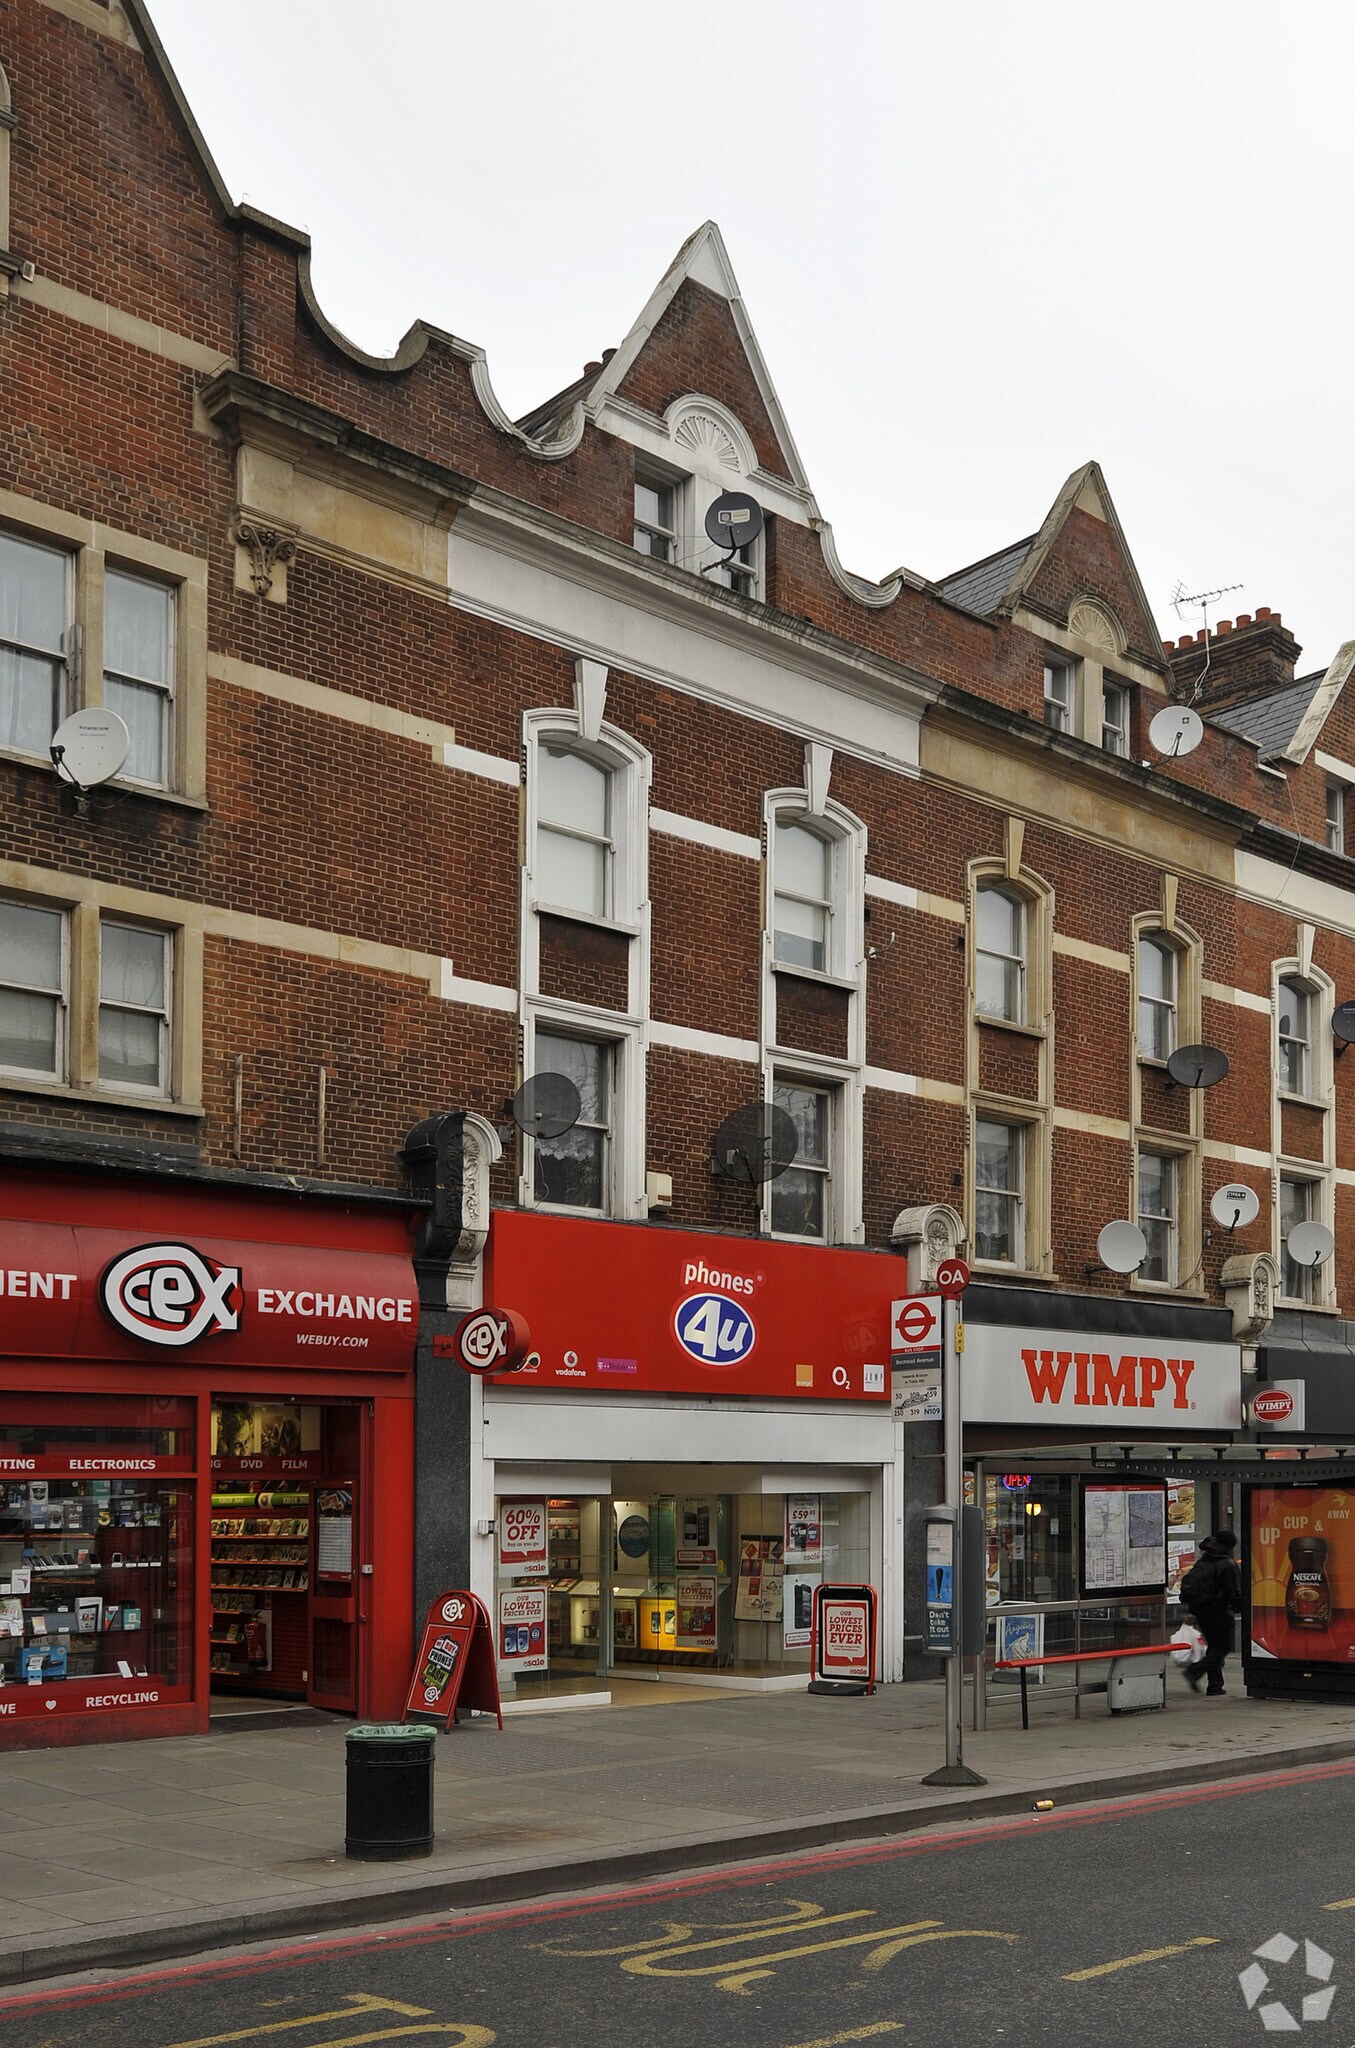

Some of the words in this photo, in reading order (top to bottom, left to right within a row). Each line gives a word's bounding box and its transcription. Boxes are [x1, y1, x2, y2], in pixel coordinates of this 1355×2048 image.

[684, 1261, 754, 1295] phones
[939, 1270, 965, 1285] OA
[258, 1289, 412, 1322] EXCHANGE
[683, 1299, 749, 1358] 4u
[296, 1334, 369, 1348] WEBUY.COM
[555, 1369, 586, 1377] vodafone
[832, 1366, 850, 1390] O2
[1021, 1349, 1194, 1409] WIMPY
[1255, 1401, 1292, 1411] WIMPY
[0, 1459, 35, 1470] TING
[69, 1459, 156, 1470] ELECTRONICS
[240, 1460, 263, 1469] DVD
[282, 1460, 308, 1469] FILM
[505, 1509, 540, 1525] 60%
[507, 1525, 540, 1541] OFF
[1259, 1528, 1281, 1545] UP
[1283, 1516, 1308, 1529] CUP
[1314, 1520, 1323, 1531] &
[1327, 1510, 1350, 1519] AWAY
[681, 1587, 712, 1595] LOWEST
[504, 1601, 542, 1611] LOWEST
[929, 1611, 949, 1619] Don't
[829, 1624, 863, 1633] PRICES
[701, 1638, 716, 1646] sale
[829, 1633, 863, 1645] EVER
[444, 1641, 456, 1653] BUY
[429, 1650, 453, 1667] PHONES
[527, 1658, 545, 1667] sale
[426, 1665, 446, 1683] CASH
[86, 1691, 159, 1708] RECYCLING
